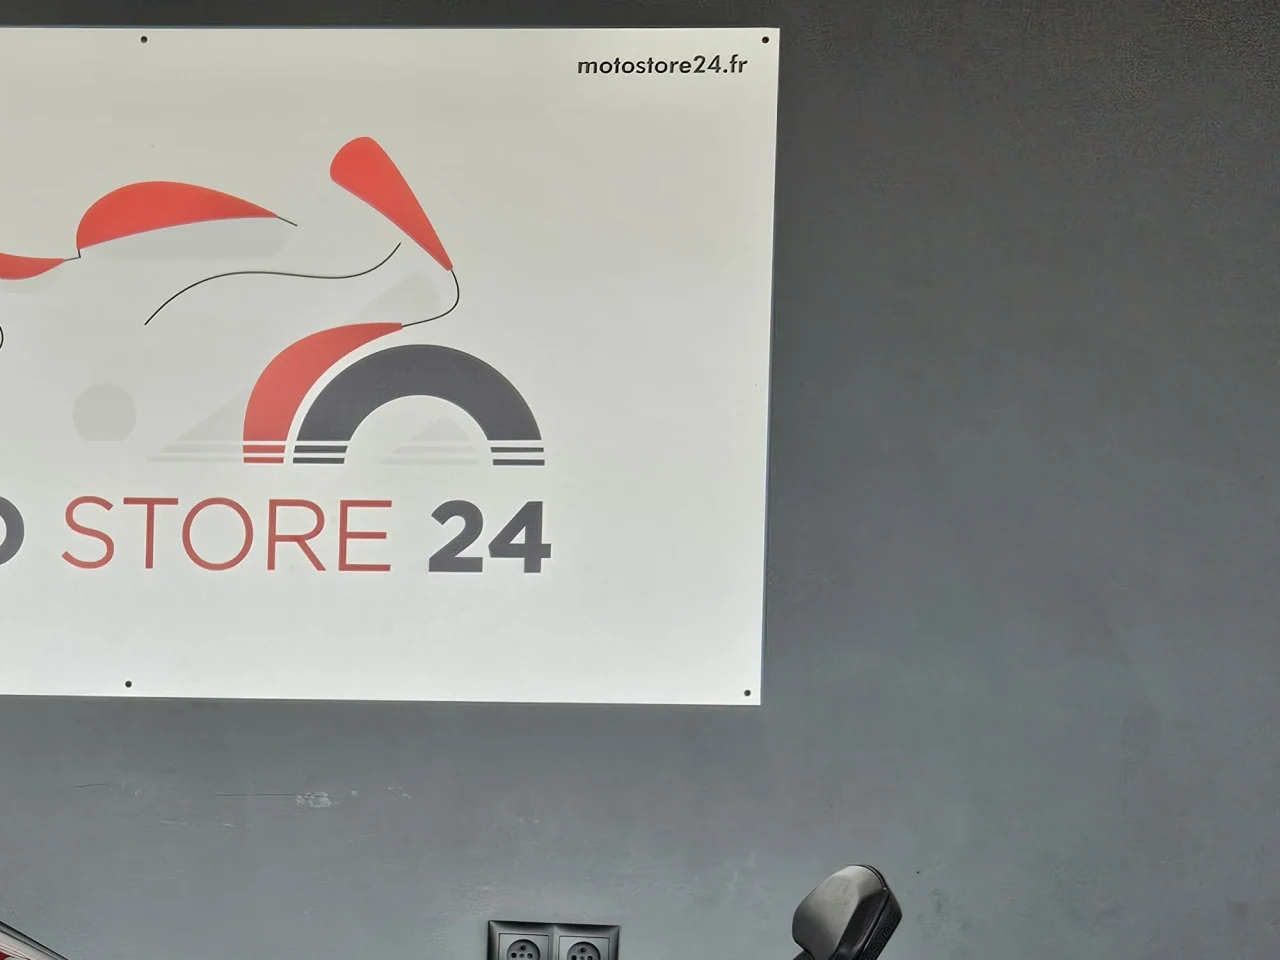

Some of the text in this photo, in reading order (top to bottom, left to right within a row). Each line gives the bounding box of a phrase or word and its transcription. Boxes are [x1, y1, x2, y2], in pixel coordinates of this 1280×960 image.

[577, 54, 749, 74] motostore24.fr
[61, 495, 393, 572] STORE
[428, 499, 553, 573] 24
